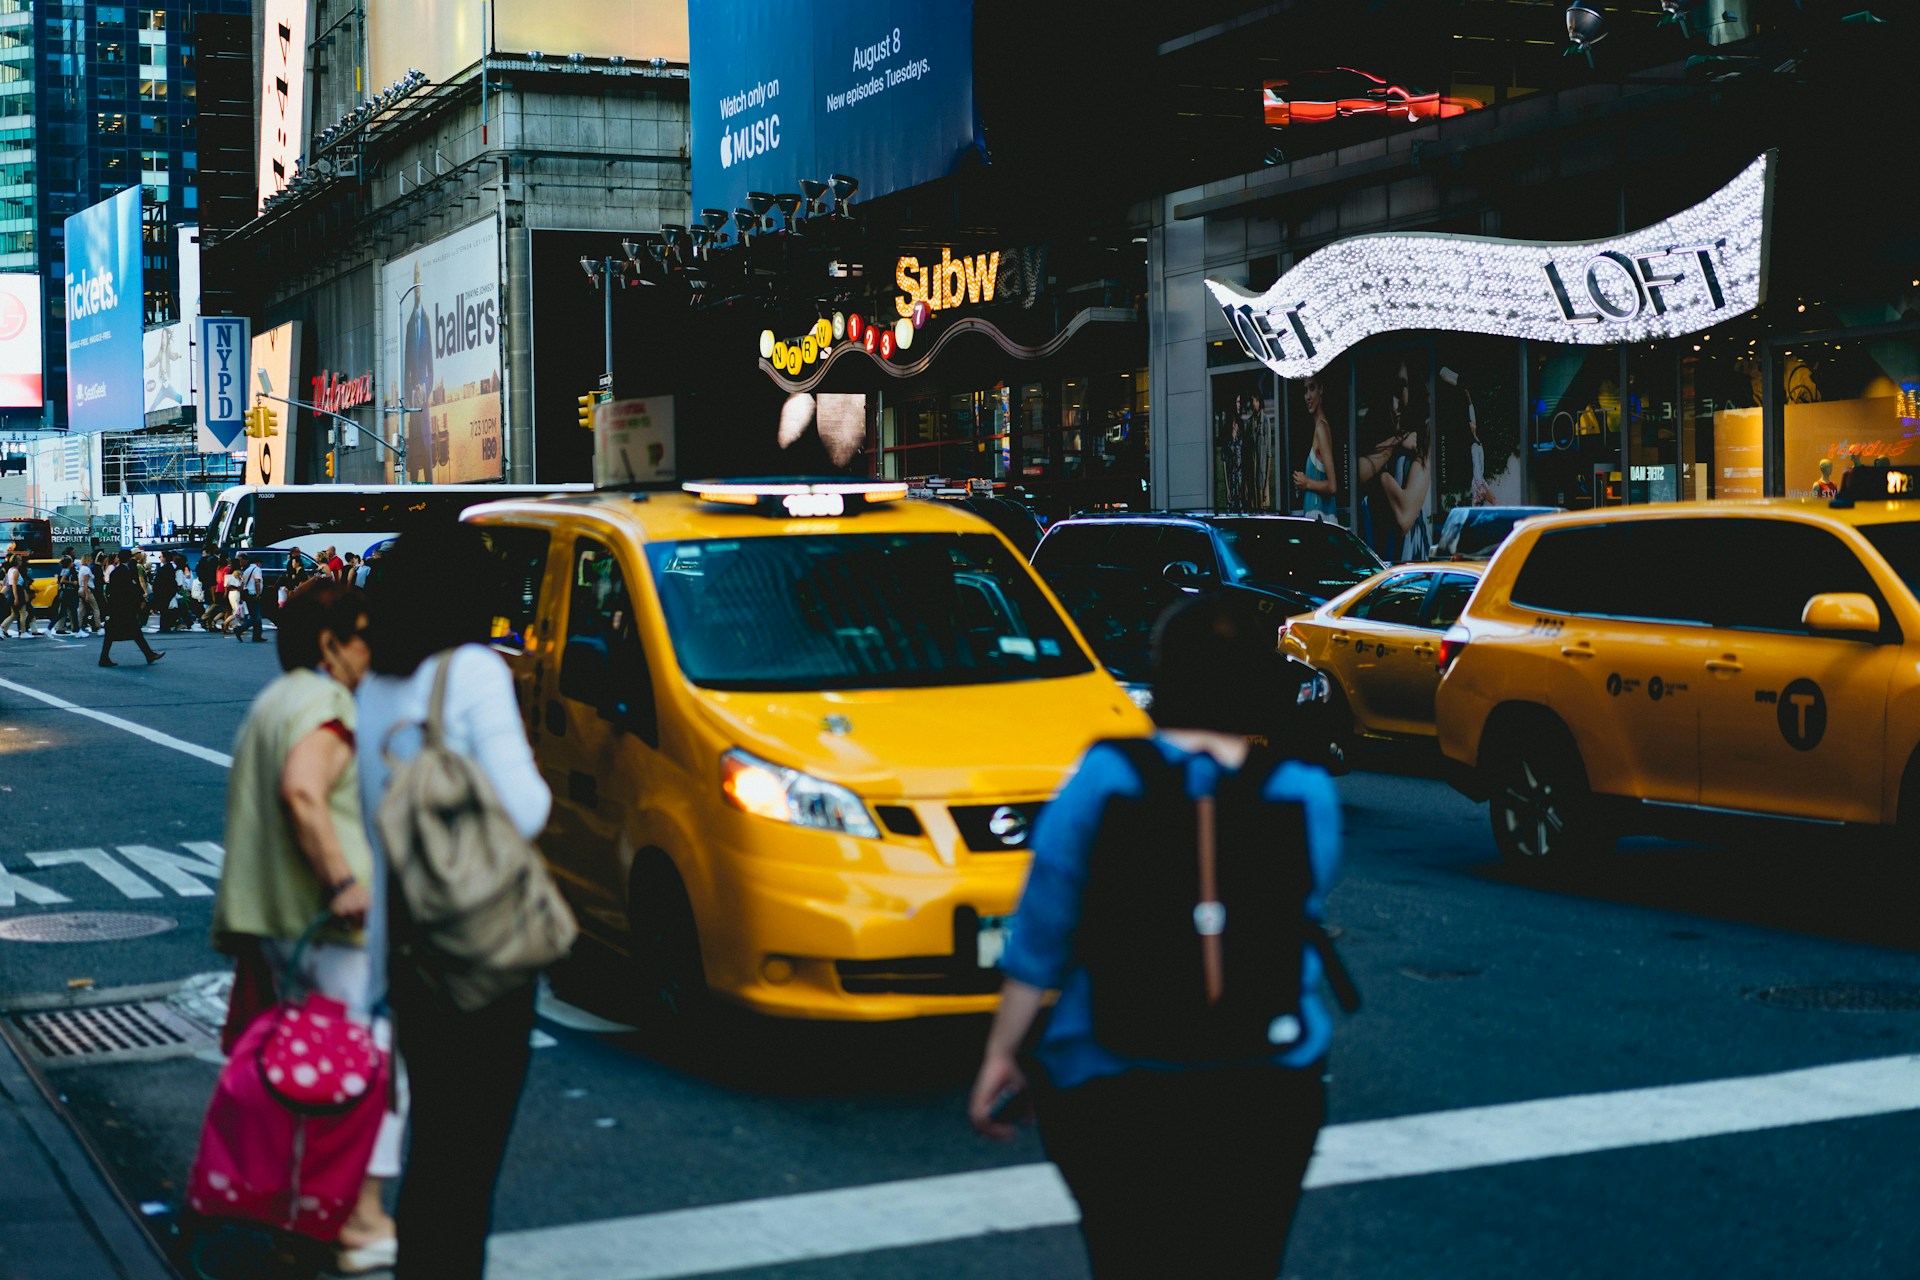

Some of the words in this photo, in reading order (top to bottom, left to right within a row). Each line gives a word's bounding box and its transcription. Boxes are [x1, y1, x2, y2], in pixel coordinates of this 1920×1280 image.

[852, 33, 891, 73] August
[892, 27, 901, 53] 8
[719, 89, 747, 121] Watch
[747, 82, 766, 109] only
[767, 78, 780, 98] on
[826, 90, 845, 114] New
[845, 75, 885, 108] episodes
[884, 56, 931, 89] Tuesdays.
[733, 113, 781, 165] MUSIC
[894, 246, 1045, 319] Subway
[1542, 238, 1727, 325] LOFT
[435, 292, 495, 360] ballers
[1220, 300, 1318, 363] LOFT
[216, 325, 233, 420] NYPD
[482, 436, 498, 461] HBO
[1535, 406, 1618, 452] LOFT
[1788, 488, 1818, 498] Where
